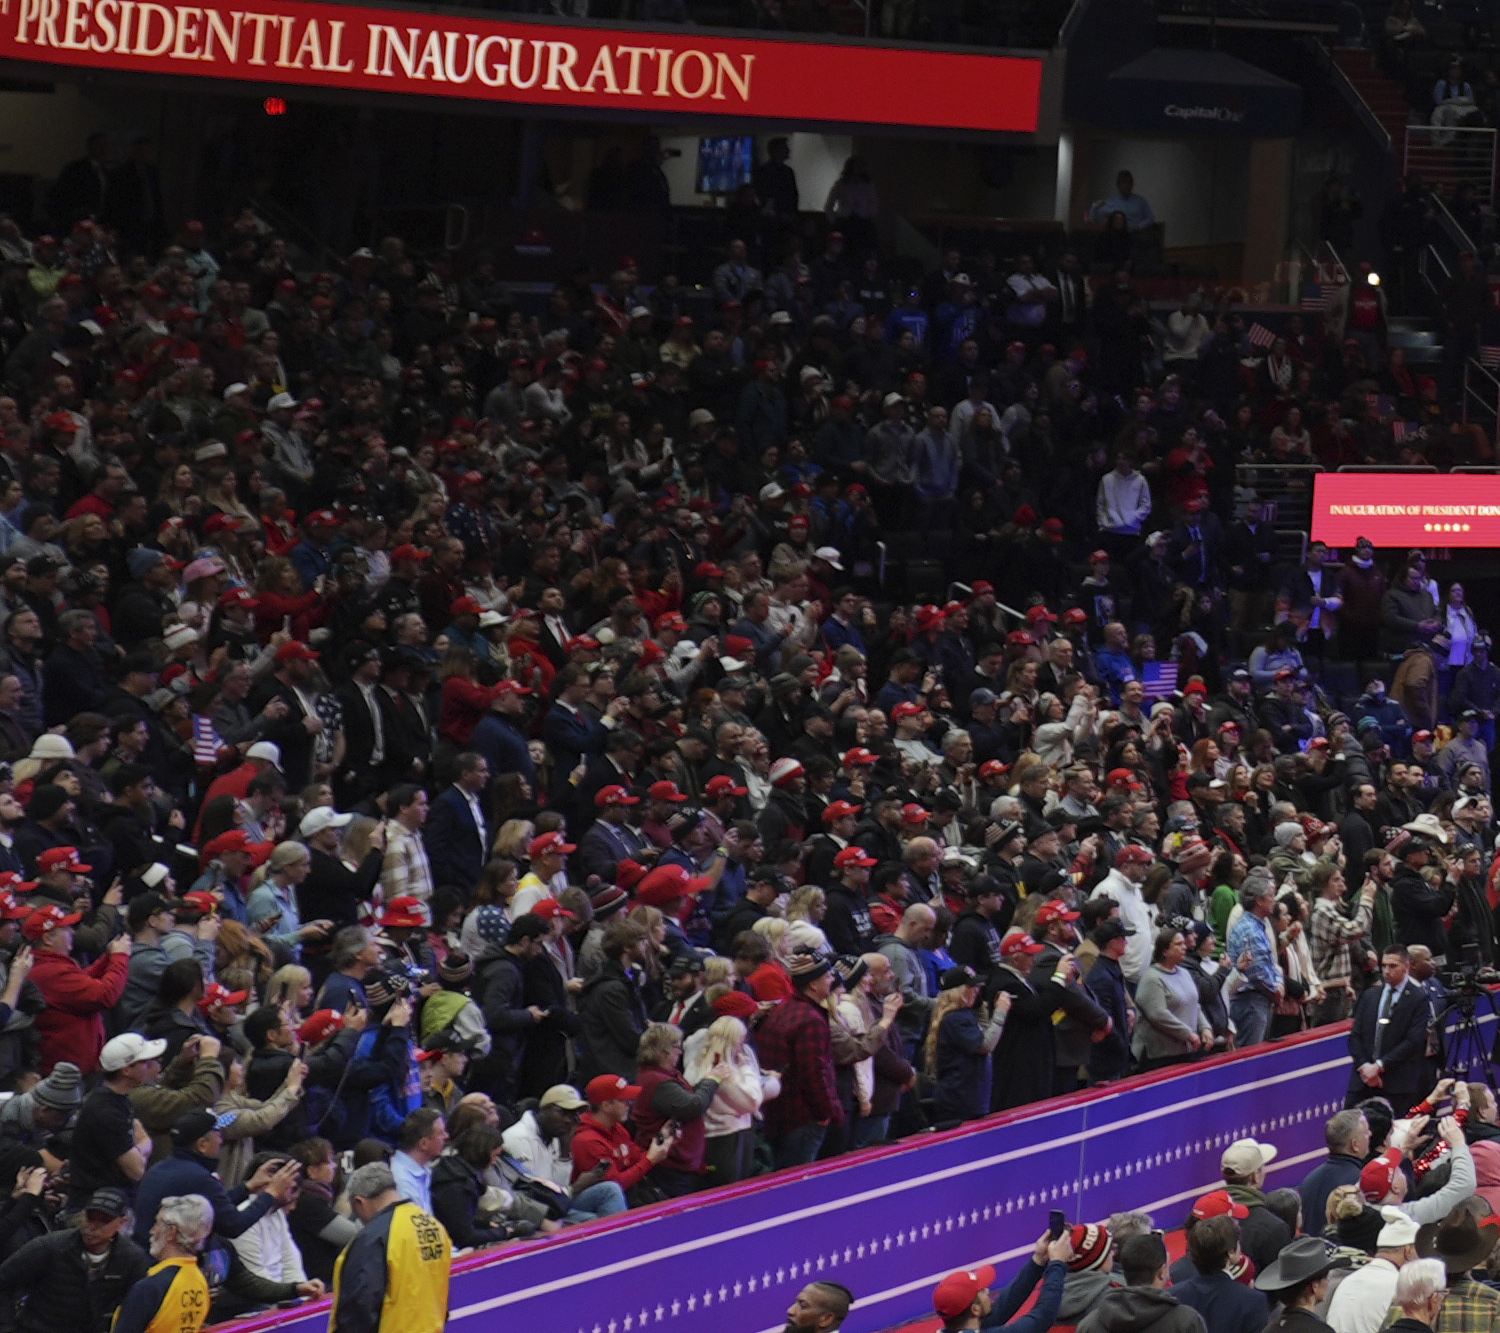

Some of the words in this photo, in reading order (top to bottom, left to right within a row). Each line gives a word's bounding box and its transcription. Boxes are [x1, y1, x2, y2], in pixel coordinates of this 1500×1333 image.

[364, 23, 756, 103] INAUGURATION
[1329, 504, 1406, 516] INAUGURATION
[1407, 504, 1421, 516] OF
[1422, 505, 1476, 517] PRESIDENT
